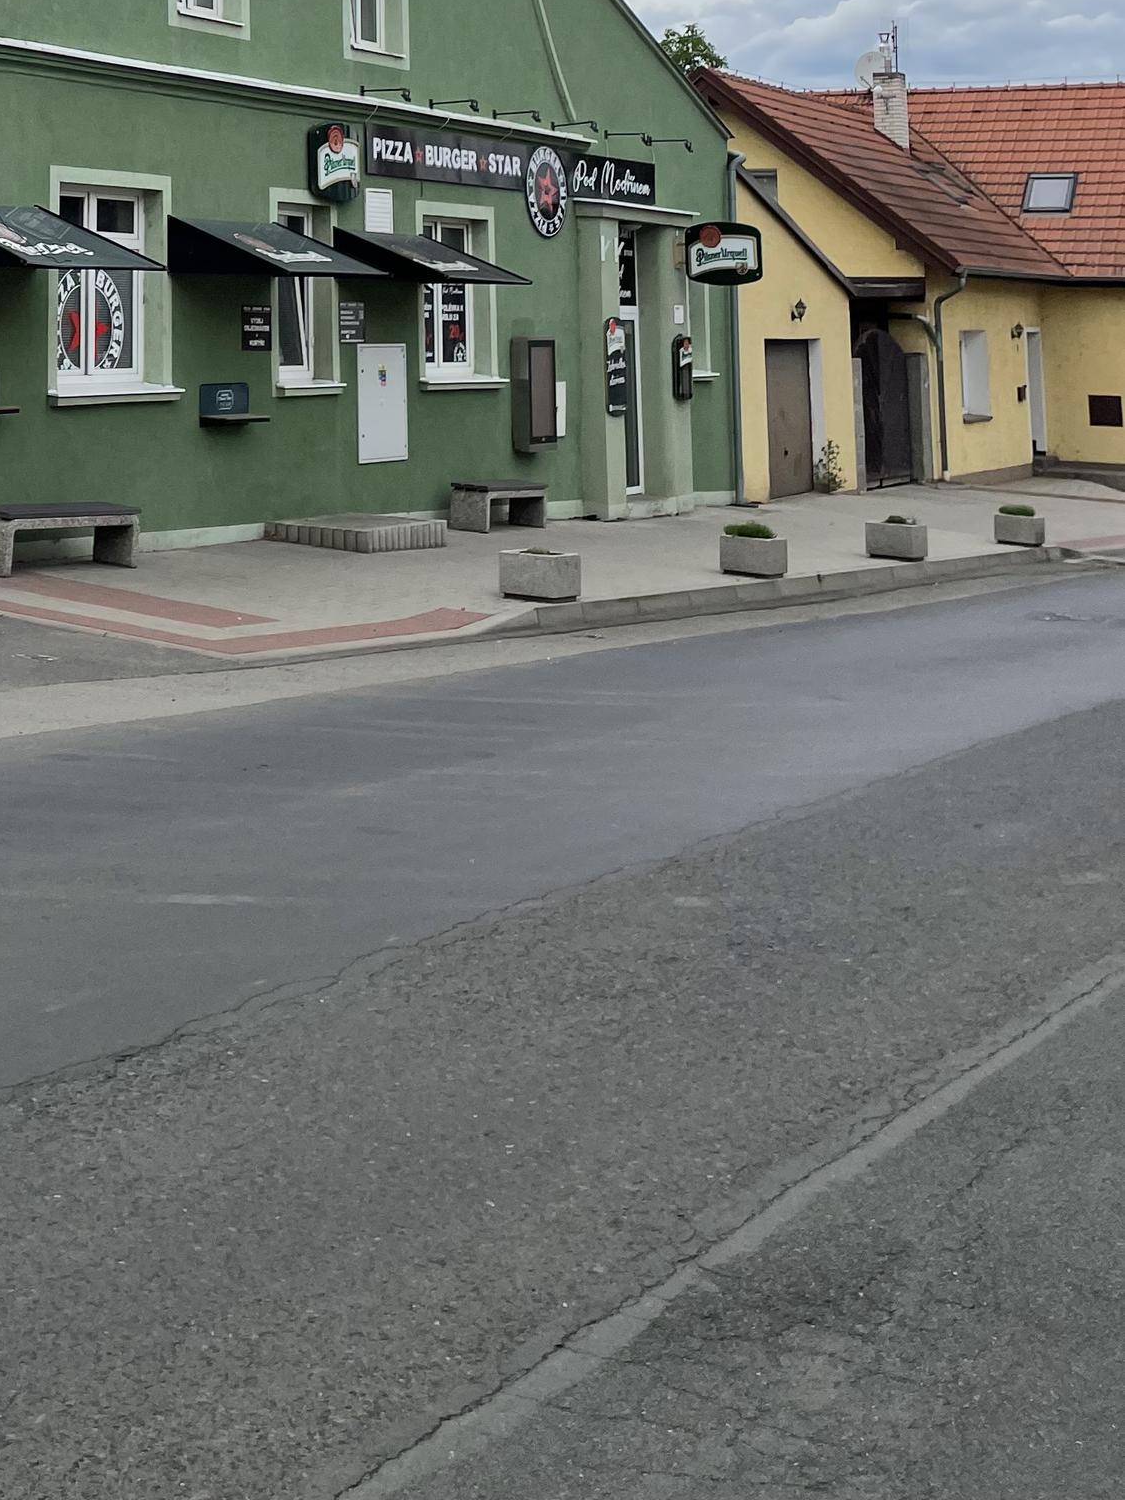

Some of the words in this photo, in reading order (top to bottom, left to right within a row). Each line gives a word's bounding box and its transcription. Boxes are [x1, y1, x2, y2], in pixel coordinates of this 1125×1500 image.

[372, 137, 413, 164] PIZZA
[425, 144, 477, 172] BURGER
[488, 153, 522, 177] STAR
[573, 160, 598, 193] Pod
[601, 160, 651, 196] Modřínem
[95, 269, 124, 358] BURGER
